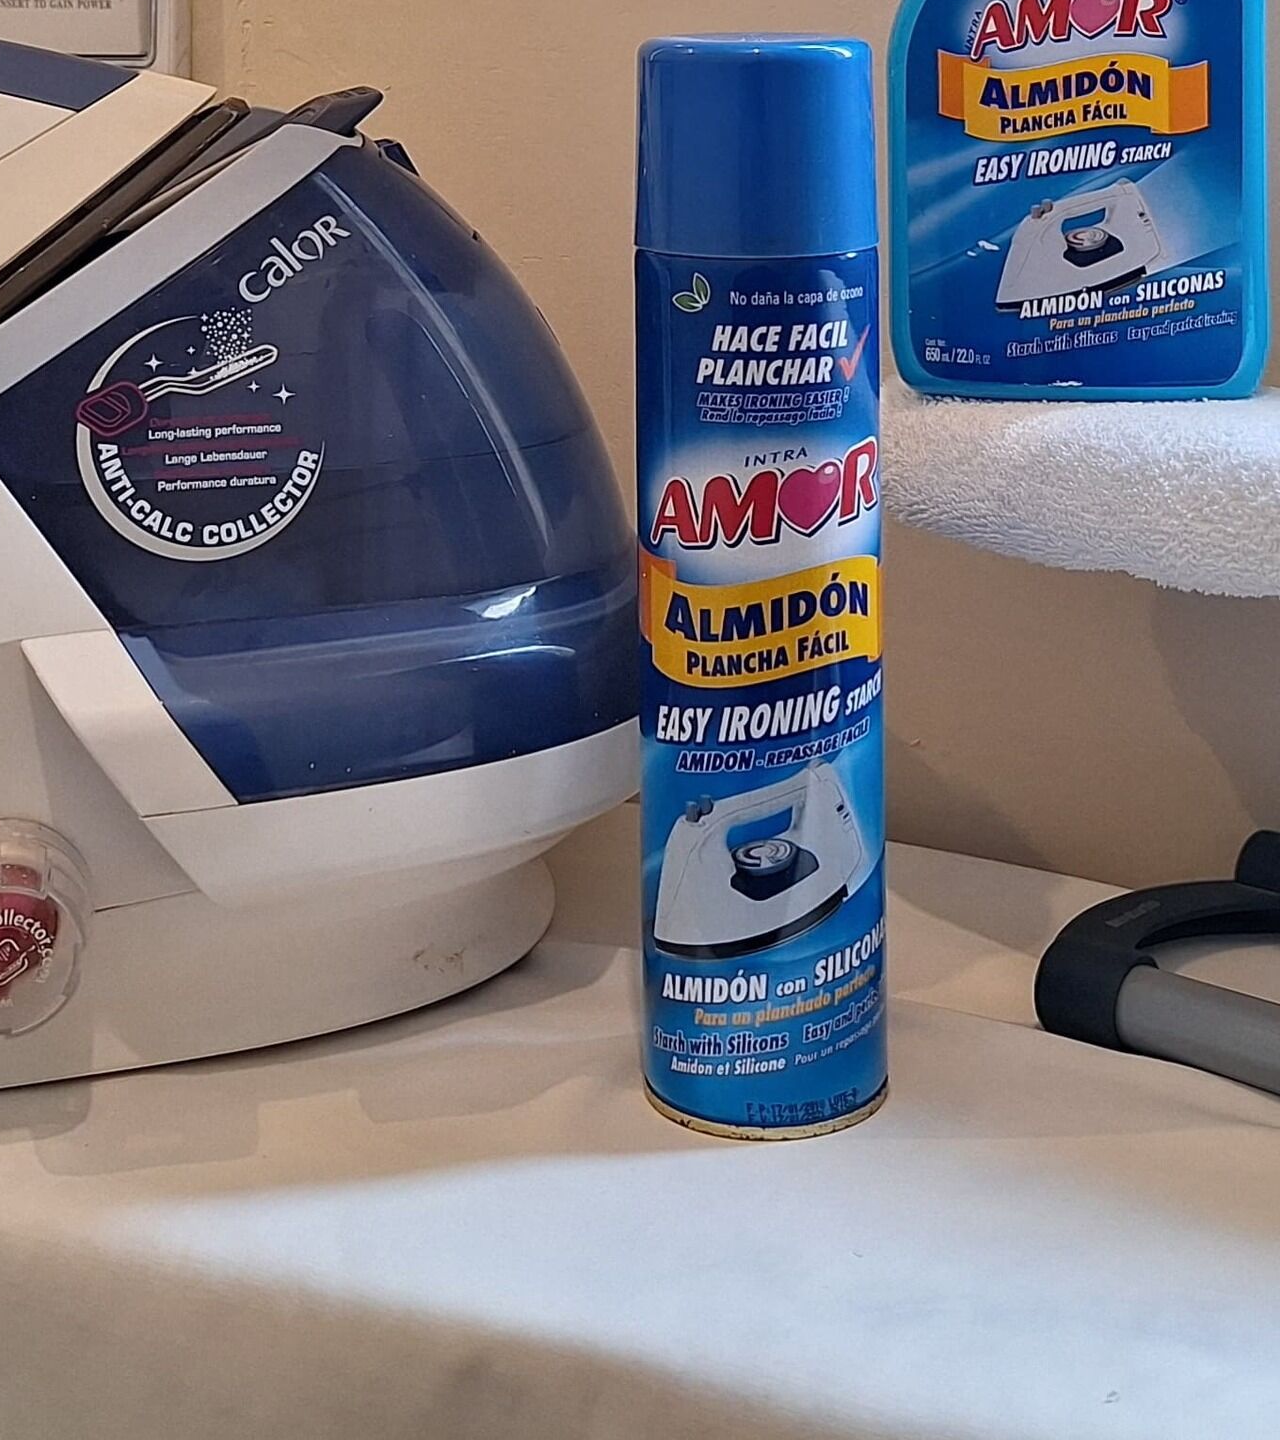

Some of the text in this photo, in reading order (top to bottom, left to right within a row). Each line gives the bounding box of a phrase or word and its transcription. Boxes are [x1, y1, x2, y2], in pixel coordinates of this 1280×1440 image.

[964, 10, 983, 51] INTRA
[979, 61, 1152, 111] ALMIDÓN
[999, 101, 1128, 135] PLANCHA FÁCIL
[974, 140, 1173, 185] EASY IRONING STARCH
[730, 290, 748, 306] No
[750, 289, 780, 306] daña
[783, 289, 795, 305] la
[797, 291, 824, 308] capa
[826, 287, 839, 303] de
[1020, 270, 1225, 320] ALMIDÓN con SILICONAS
[1049, 298, 1196, 332] Para un planchado perfecto
[712, 320, 849, 353] HACE FACIL
[925, 347, 941, 362] 650
[1006, 336, 1043, 358] Starch
[1044, 332, 1072, 353] with
[1150, 320, 1170, 336] and
[696, 355, 834, 386] PLANCHAR
[696, 392, 742, 409] MAKES
[744, 393, 803, 409] IRONING
[803, 388, 843, 406] EASIER
[147, 423, 282, 441] Long-lasting performance
[164, 449, 268, 466] Lange Lebensdauer
[744, 446, 809, 468] INTRA
[96, 441, 320, 546] ANTI-CALC COLLECTOR
[157, 475, 277, 492] Performance duratura
[650, 435, 879, 547] AMOR
[664, 572, 869, 642] ALMIDÓN
[686, 631, 849, 677] PLANCHA FÁCIL
[656, 704, 713, 743] EASY
[718, 685, 842, 742] IRONING
[676, 748, 756, 773] AMIDON
[764, 734, 838, 768] REPASSAGE
[837, 717, 870, 749] FACILE
[662, 969, 768, 1005] ALMIDÓN
[775, 976, 807, 997] con
[694, 1007, 727, 1026] Para
[731, 1009, 752, 1025] un
[754, 991, 831, 1028] planchado
[653, 1025, 687, 1054] Starch
[688, 1034, 724, 1057] with
[726, 1031, 790, 1056] Silicons
[802, 1021, 832, 1045] Easy
[832, 1000, 855, 1030] and
[670, 1055, 713, 1076] Amidon
[715, 1059, 731, 1076] et
[732, 1056, 787, 1076] Silicone
[794, 1051, 819, 1066] Pour
